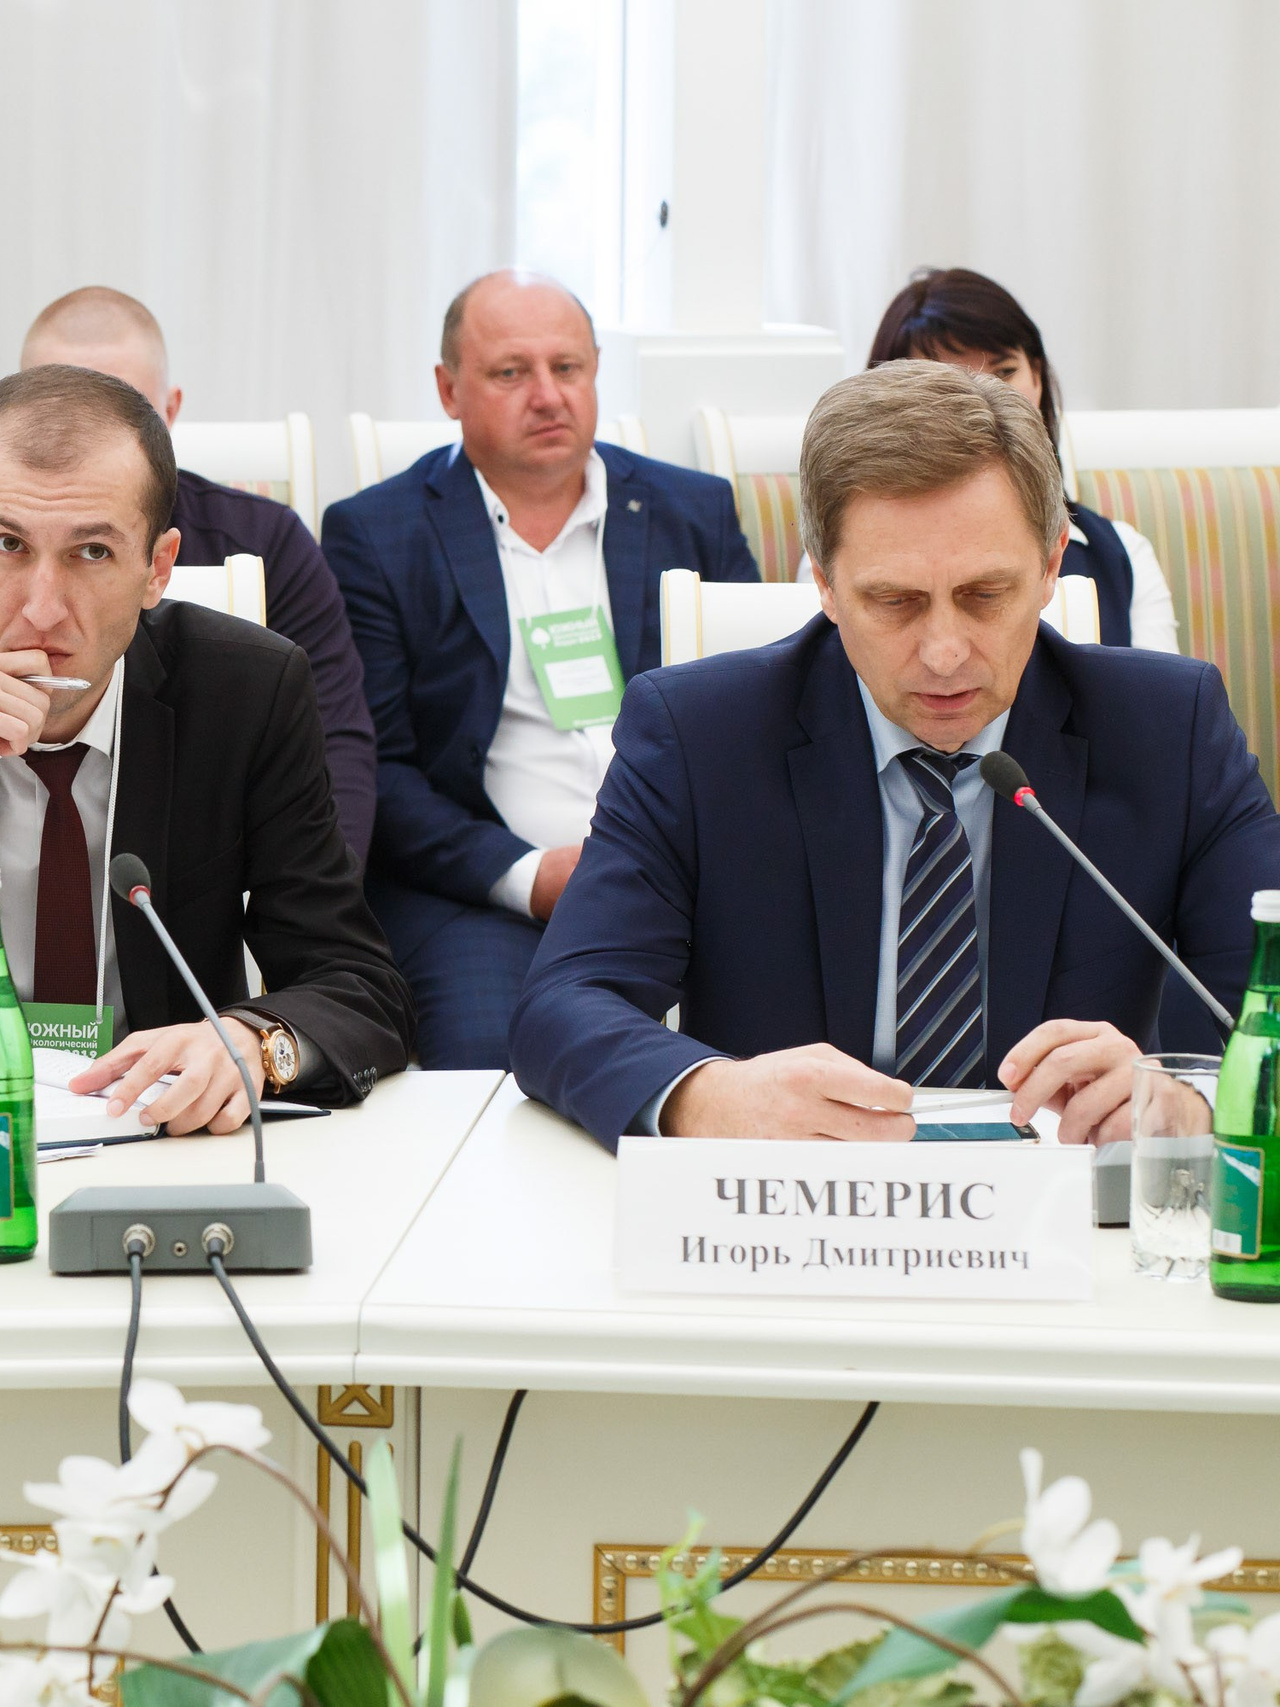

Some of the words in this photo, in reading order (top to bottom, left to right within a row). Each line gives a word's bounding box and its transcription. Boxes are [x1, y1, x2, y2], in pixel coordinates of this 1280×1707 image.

[30, 1039, 98, 1049] кологический
[714, 1177, 995, 1221] ЧЕМЕРИС
[680, 1235, 791, 1273] Игорь
[801, 1238, 1029, 1276] Дмитриевич
